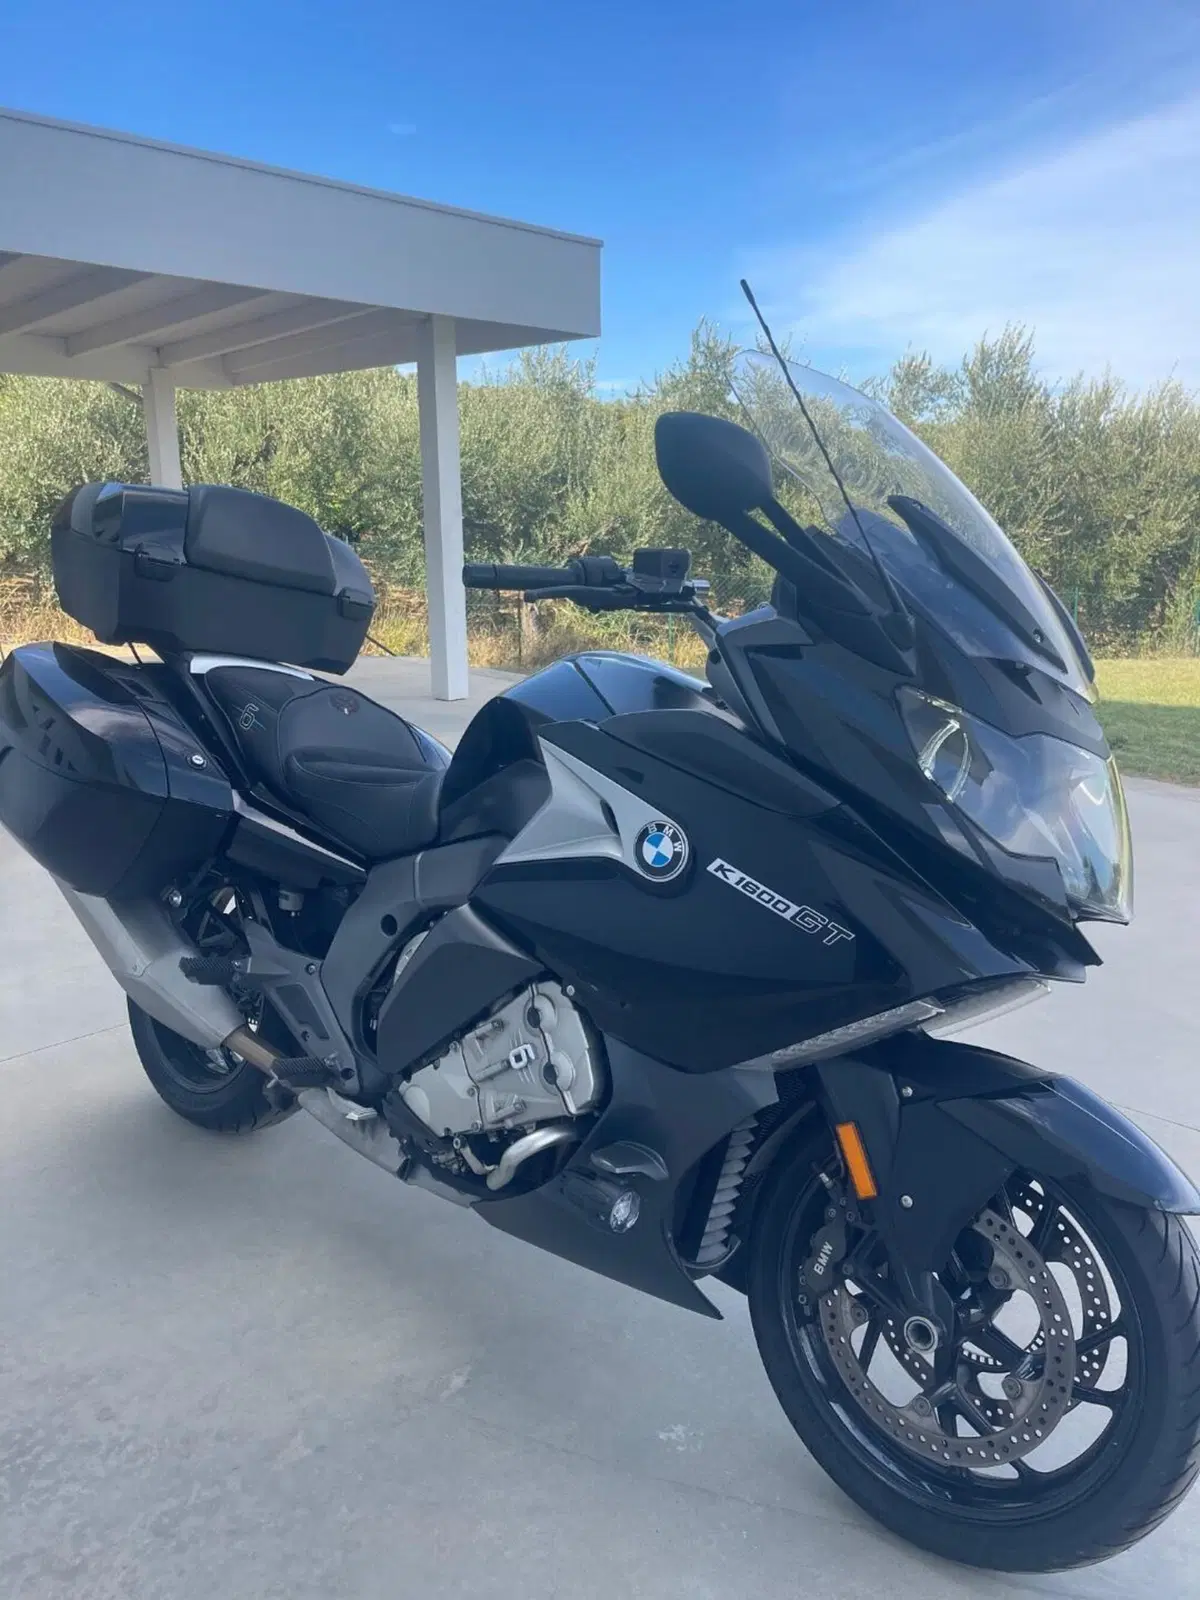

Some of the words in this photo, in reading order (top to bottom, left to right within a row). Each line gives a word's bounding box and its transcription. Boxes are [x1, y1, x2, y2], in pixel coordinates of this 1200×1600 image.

[239, 703, 260, 730] 6
[647, 823, 682, 852] BMW
[813, 1241, 833, 1275] BMW
